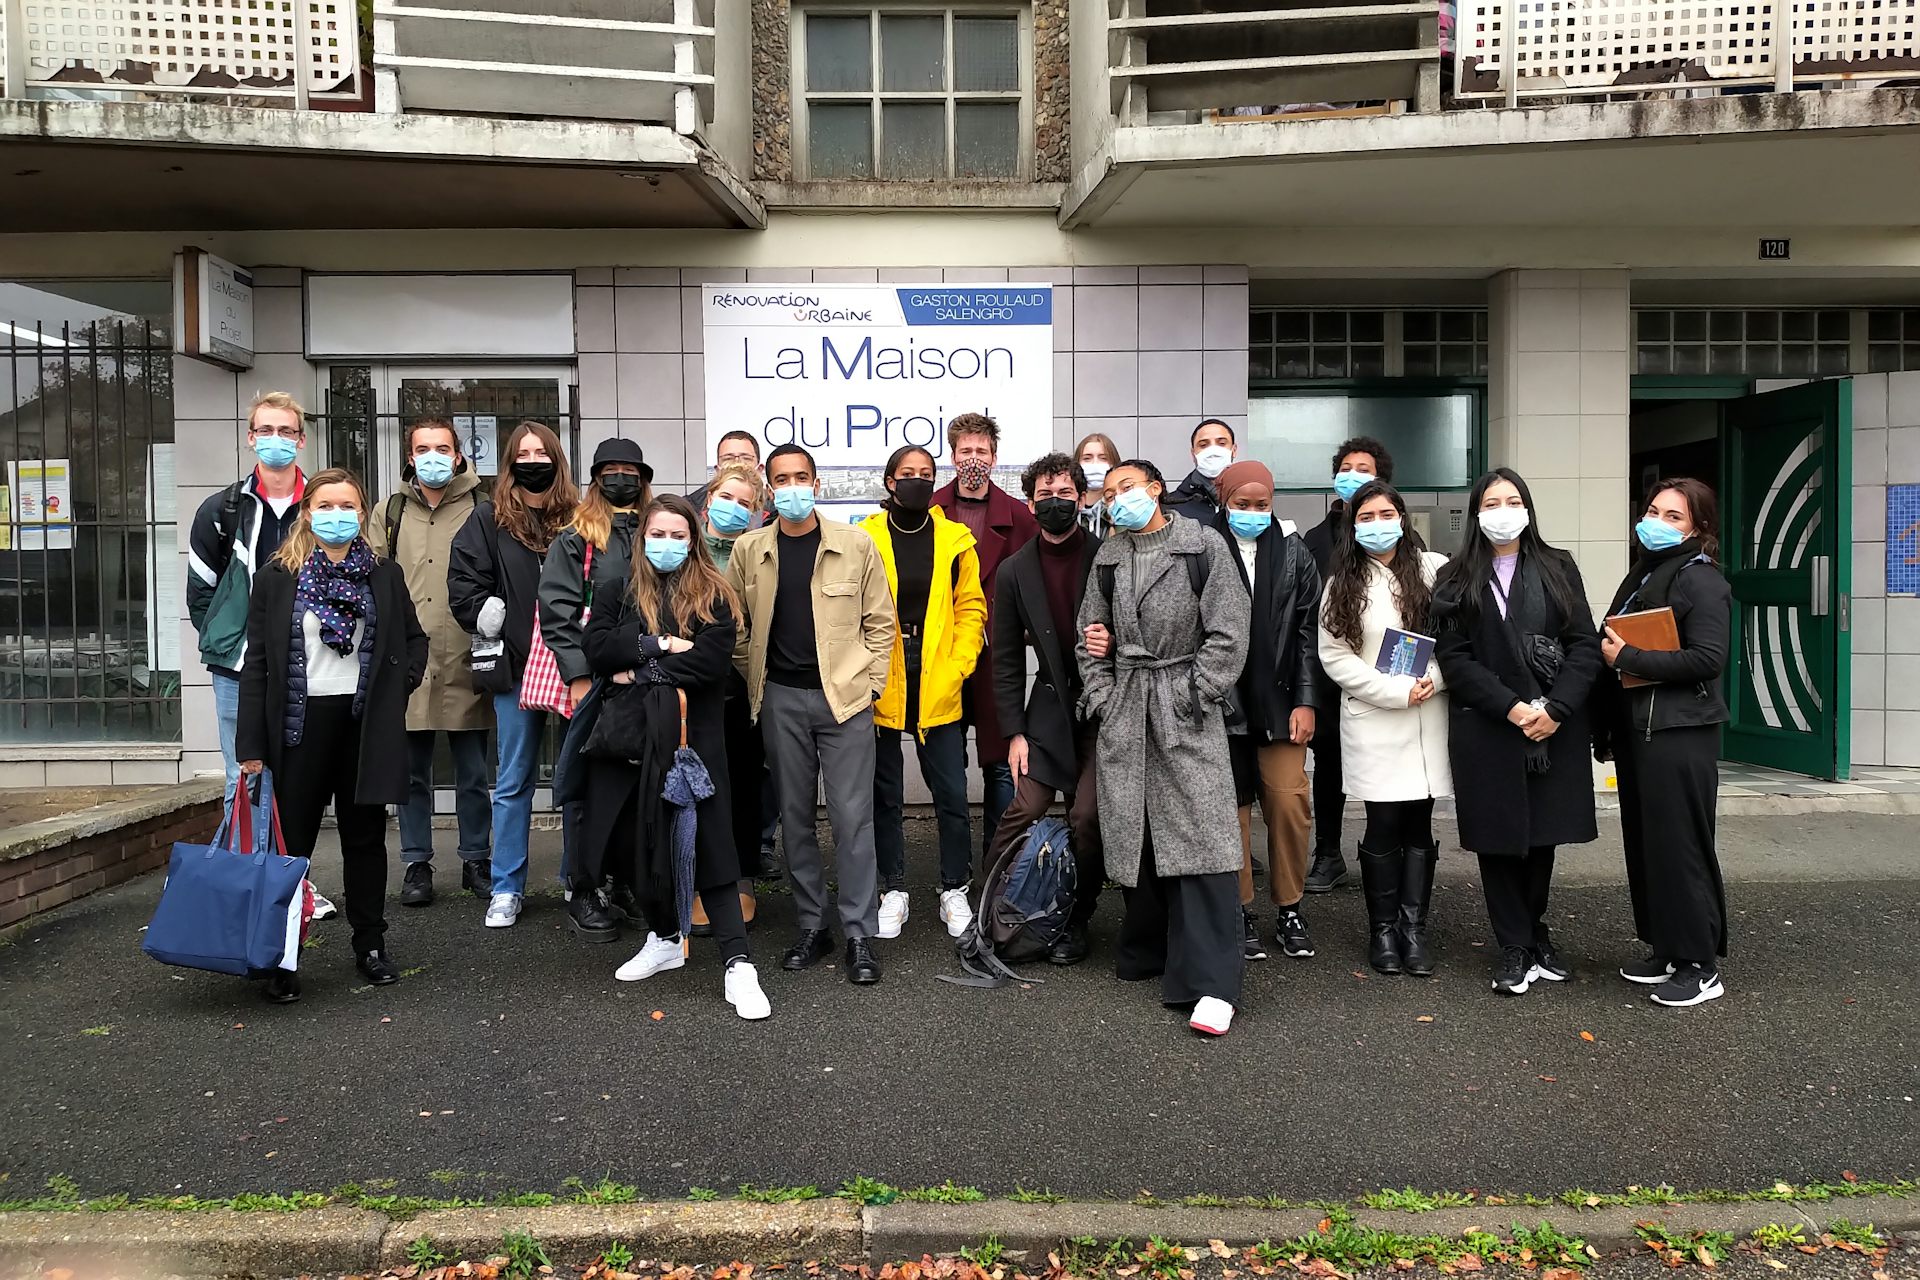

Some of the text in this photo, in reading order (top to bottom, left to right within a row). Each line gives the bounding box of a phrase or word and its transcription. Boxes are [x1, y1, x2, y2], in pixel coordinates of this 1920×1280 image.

[1766, 241, 1785, 256] 120
[910, 293, 1044, 307] GASTON ROULAUD
[935, 307, 1013, 321] SALENGRO
[744, 336, 1014, 380] La Maison
[763, 404, 998, 459] du Proj
